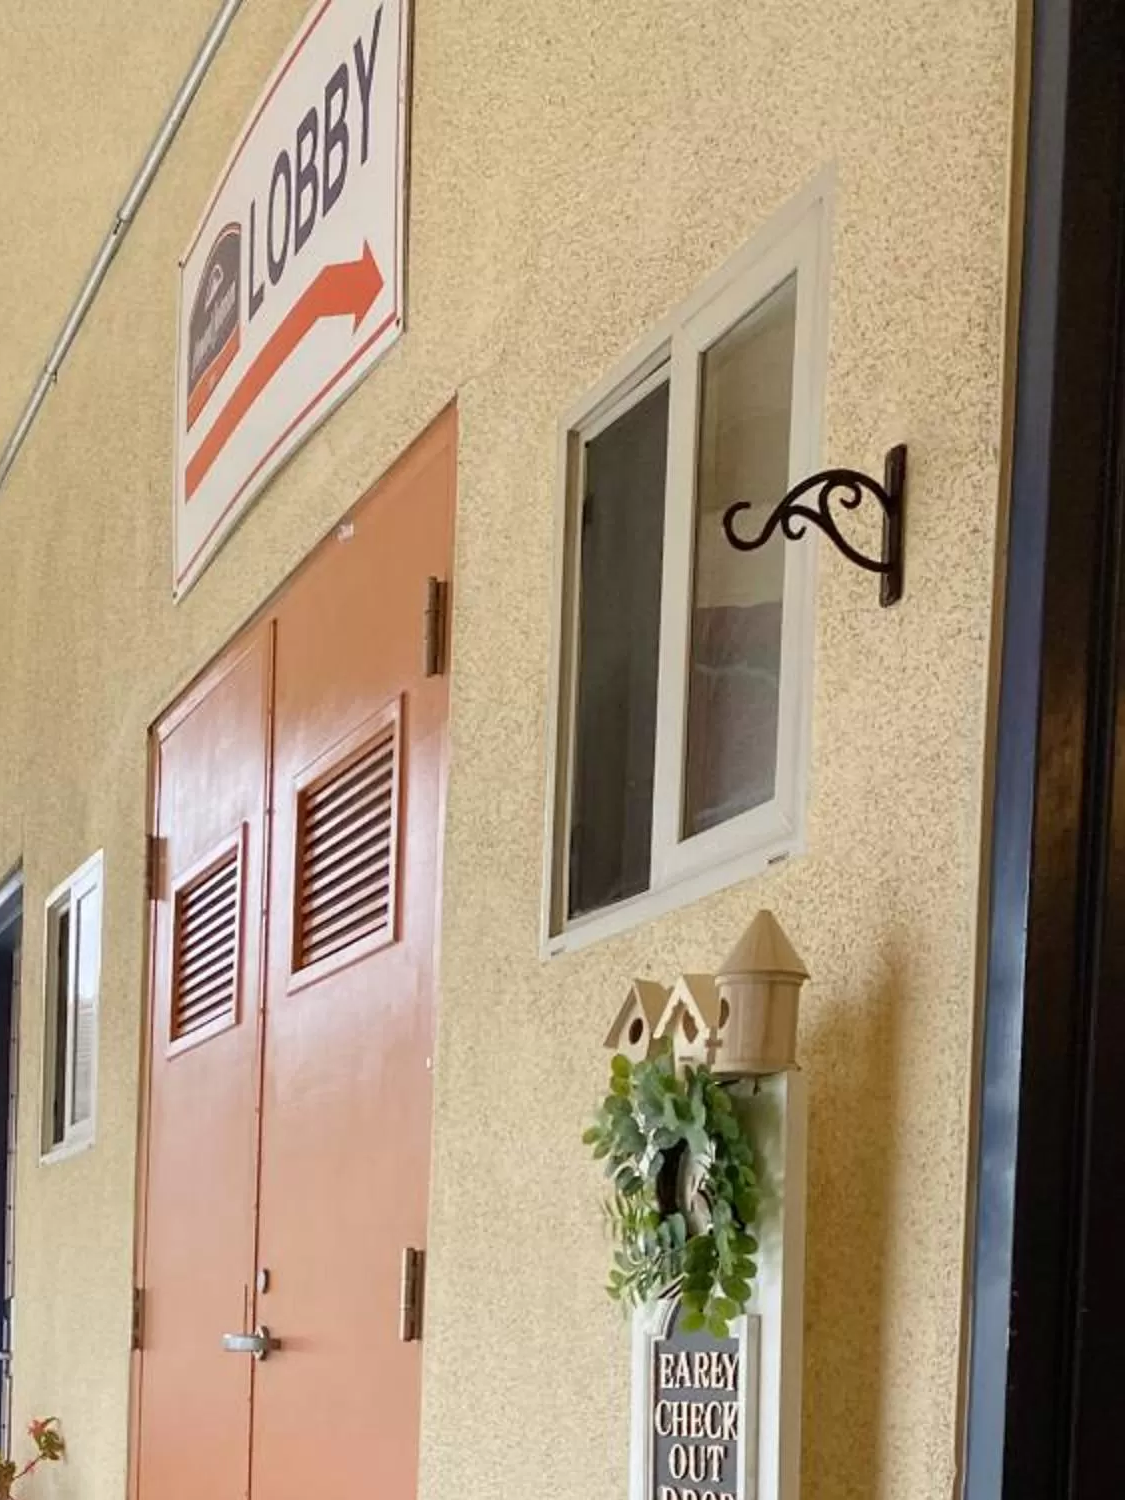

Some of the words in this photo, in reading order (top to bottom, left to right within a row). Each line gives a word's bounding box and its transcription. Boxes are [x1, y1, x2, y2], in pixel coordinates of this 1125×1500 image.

[248, 4, 383, 323] LOBBY
[655, 1399, 740, 1441] CHECK
[668, 1443, 725, 1483] OUT
